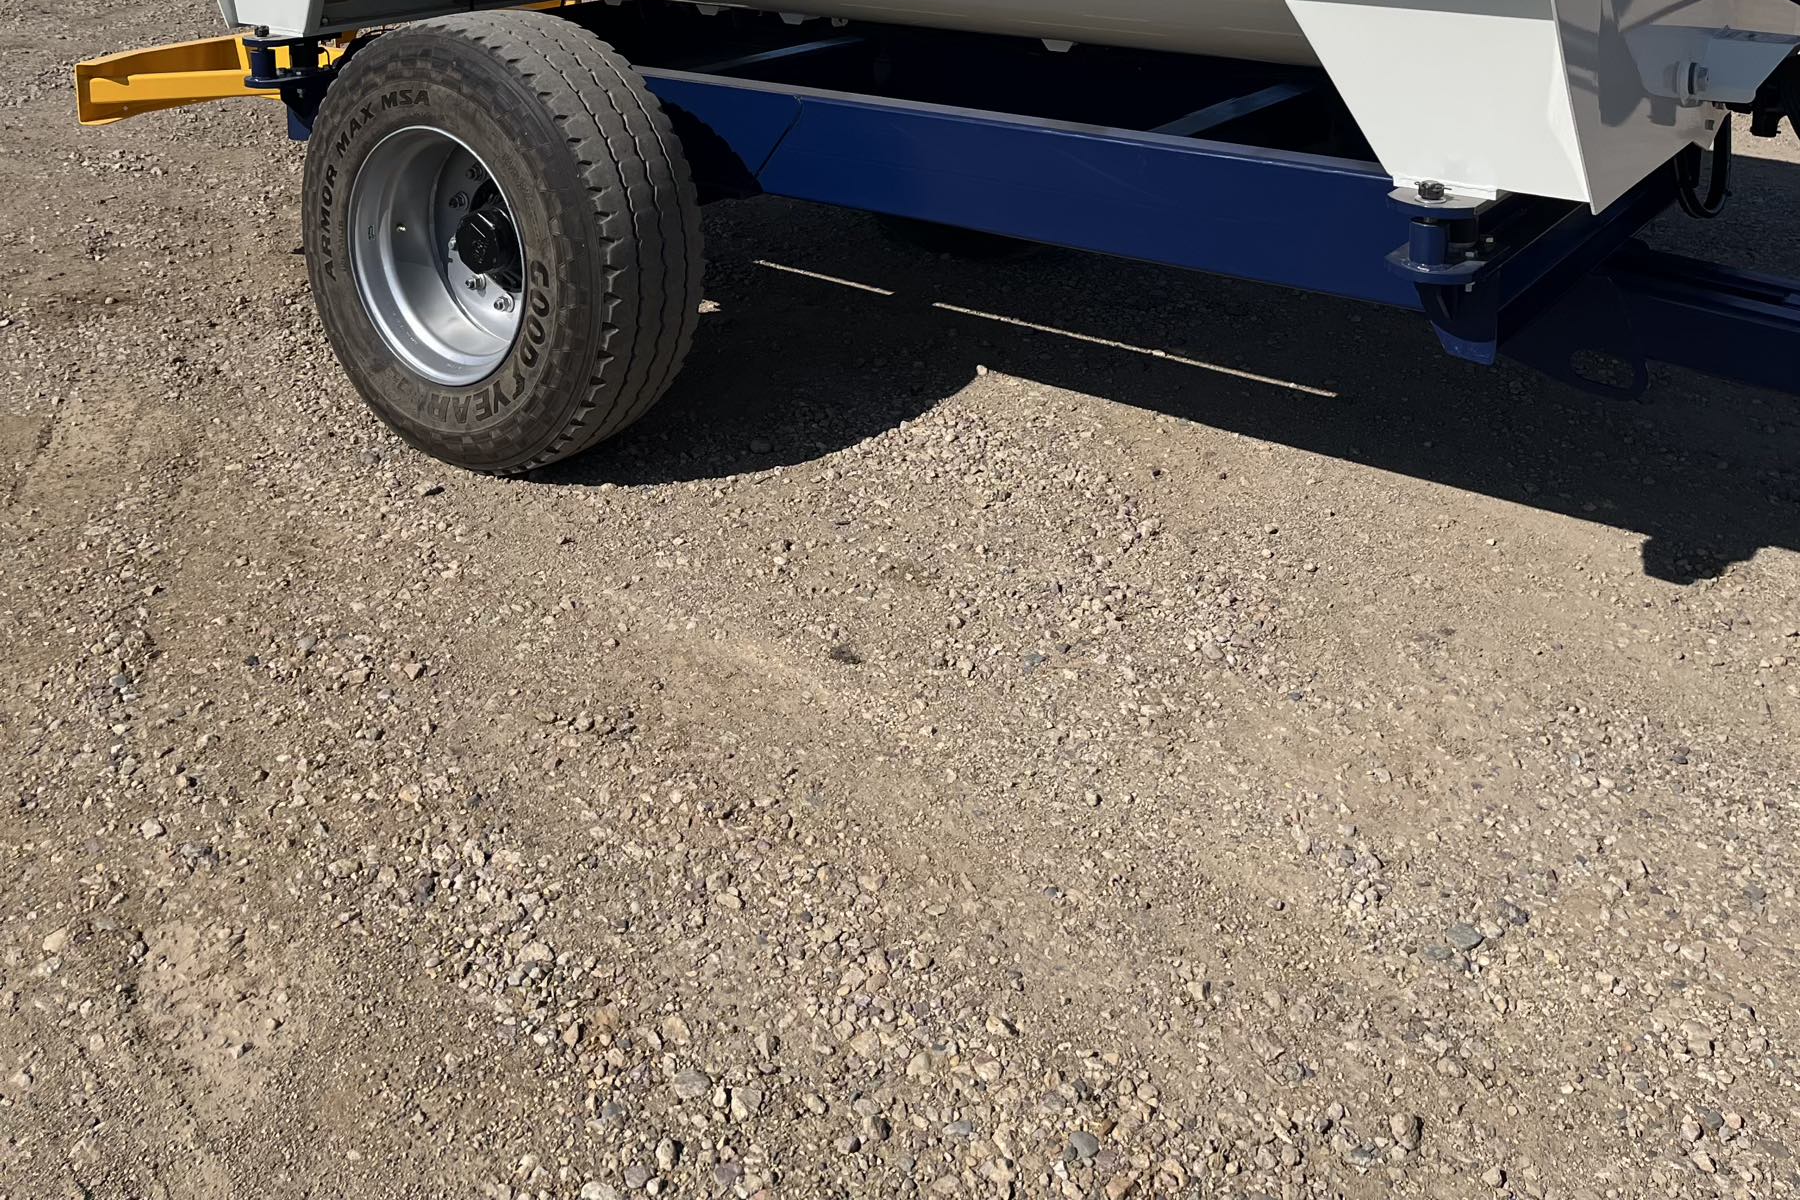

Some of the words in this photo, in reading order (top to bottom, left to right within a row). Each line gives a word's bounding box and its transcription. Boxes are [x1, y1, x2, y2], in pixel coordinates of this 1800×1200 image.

[319, 164, 338, 282] ARMOR
[335, 102, 377, 159] MAX
[381, 89, 431, 111] MSA
